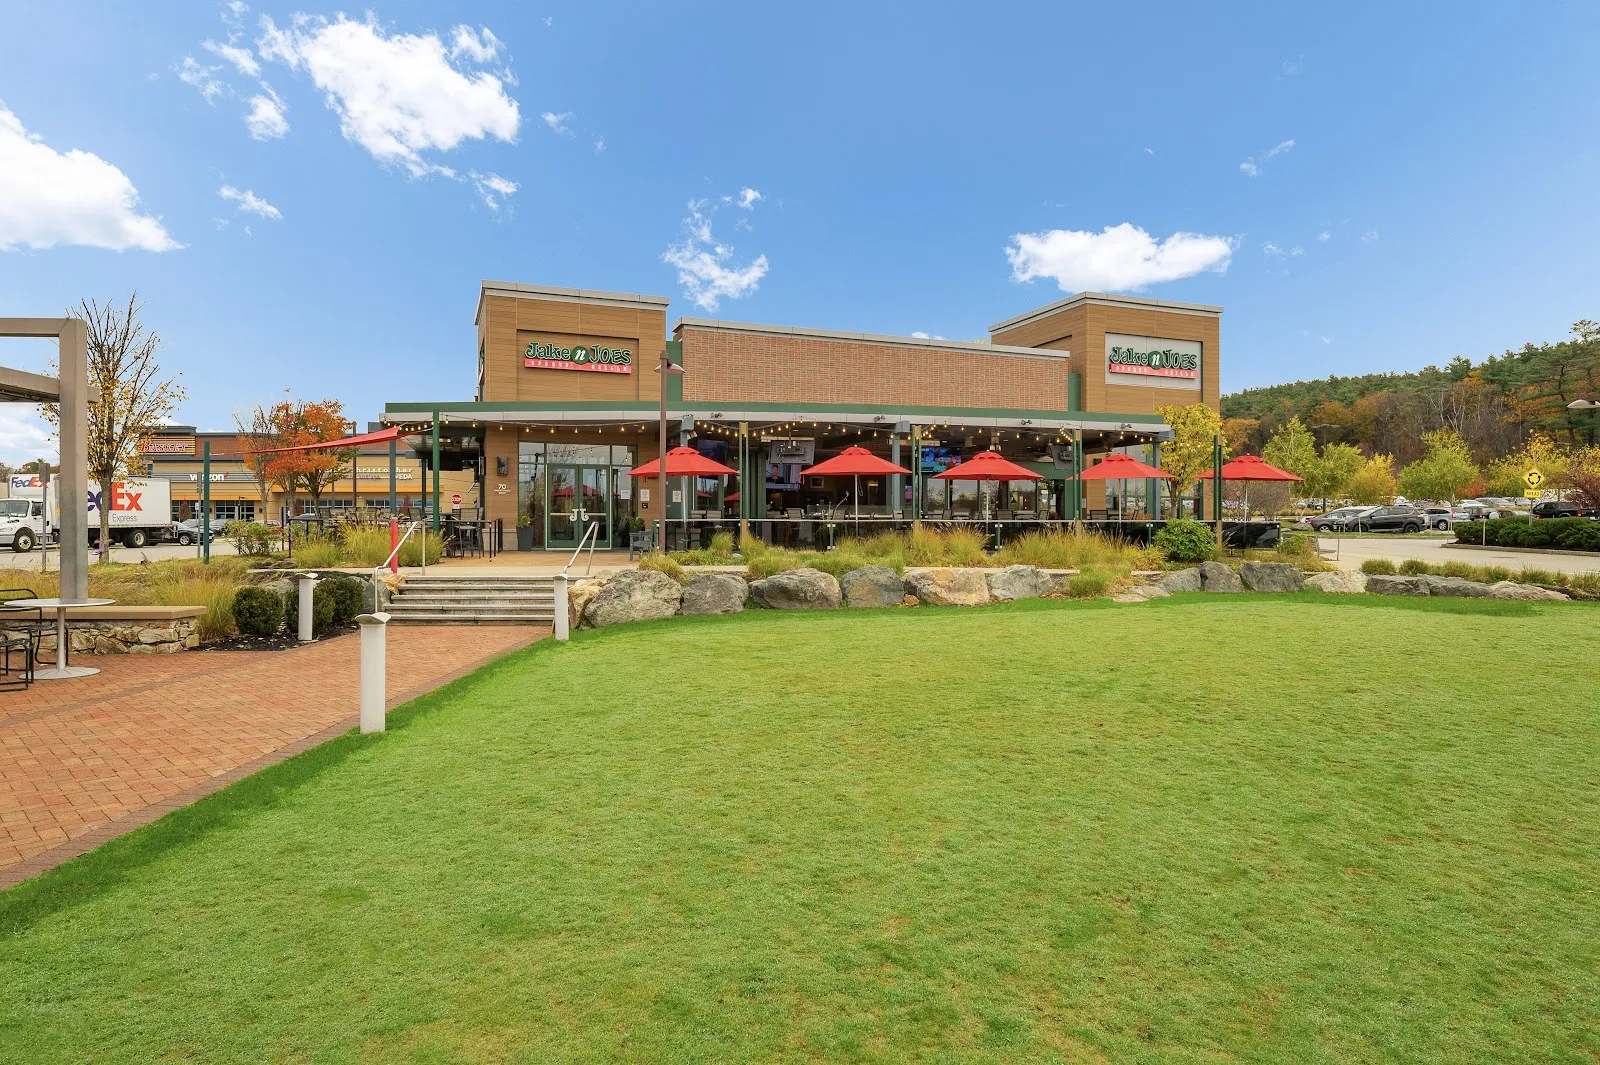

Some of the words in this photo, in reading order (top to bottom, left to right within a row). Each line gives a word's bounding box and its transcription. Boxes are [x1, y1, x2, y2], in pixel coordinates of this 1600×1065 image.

[525, 341, 571, 360] Jake
[575, 350, 586, 360] n
[589, 344, 632, 365] JOES
[1109, 347, 1148, 365] Jake
[1152, 354, 1161, 366] n
[1163, 349, 1198, 369] JOES
[189, 473, 225, 481] vrzon
[87, 482, 143, 511] edEx
[112, 513, 138, 523] Express
